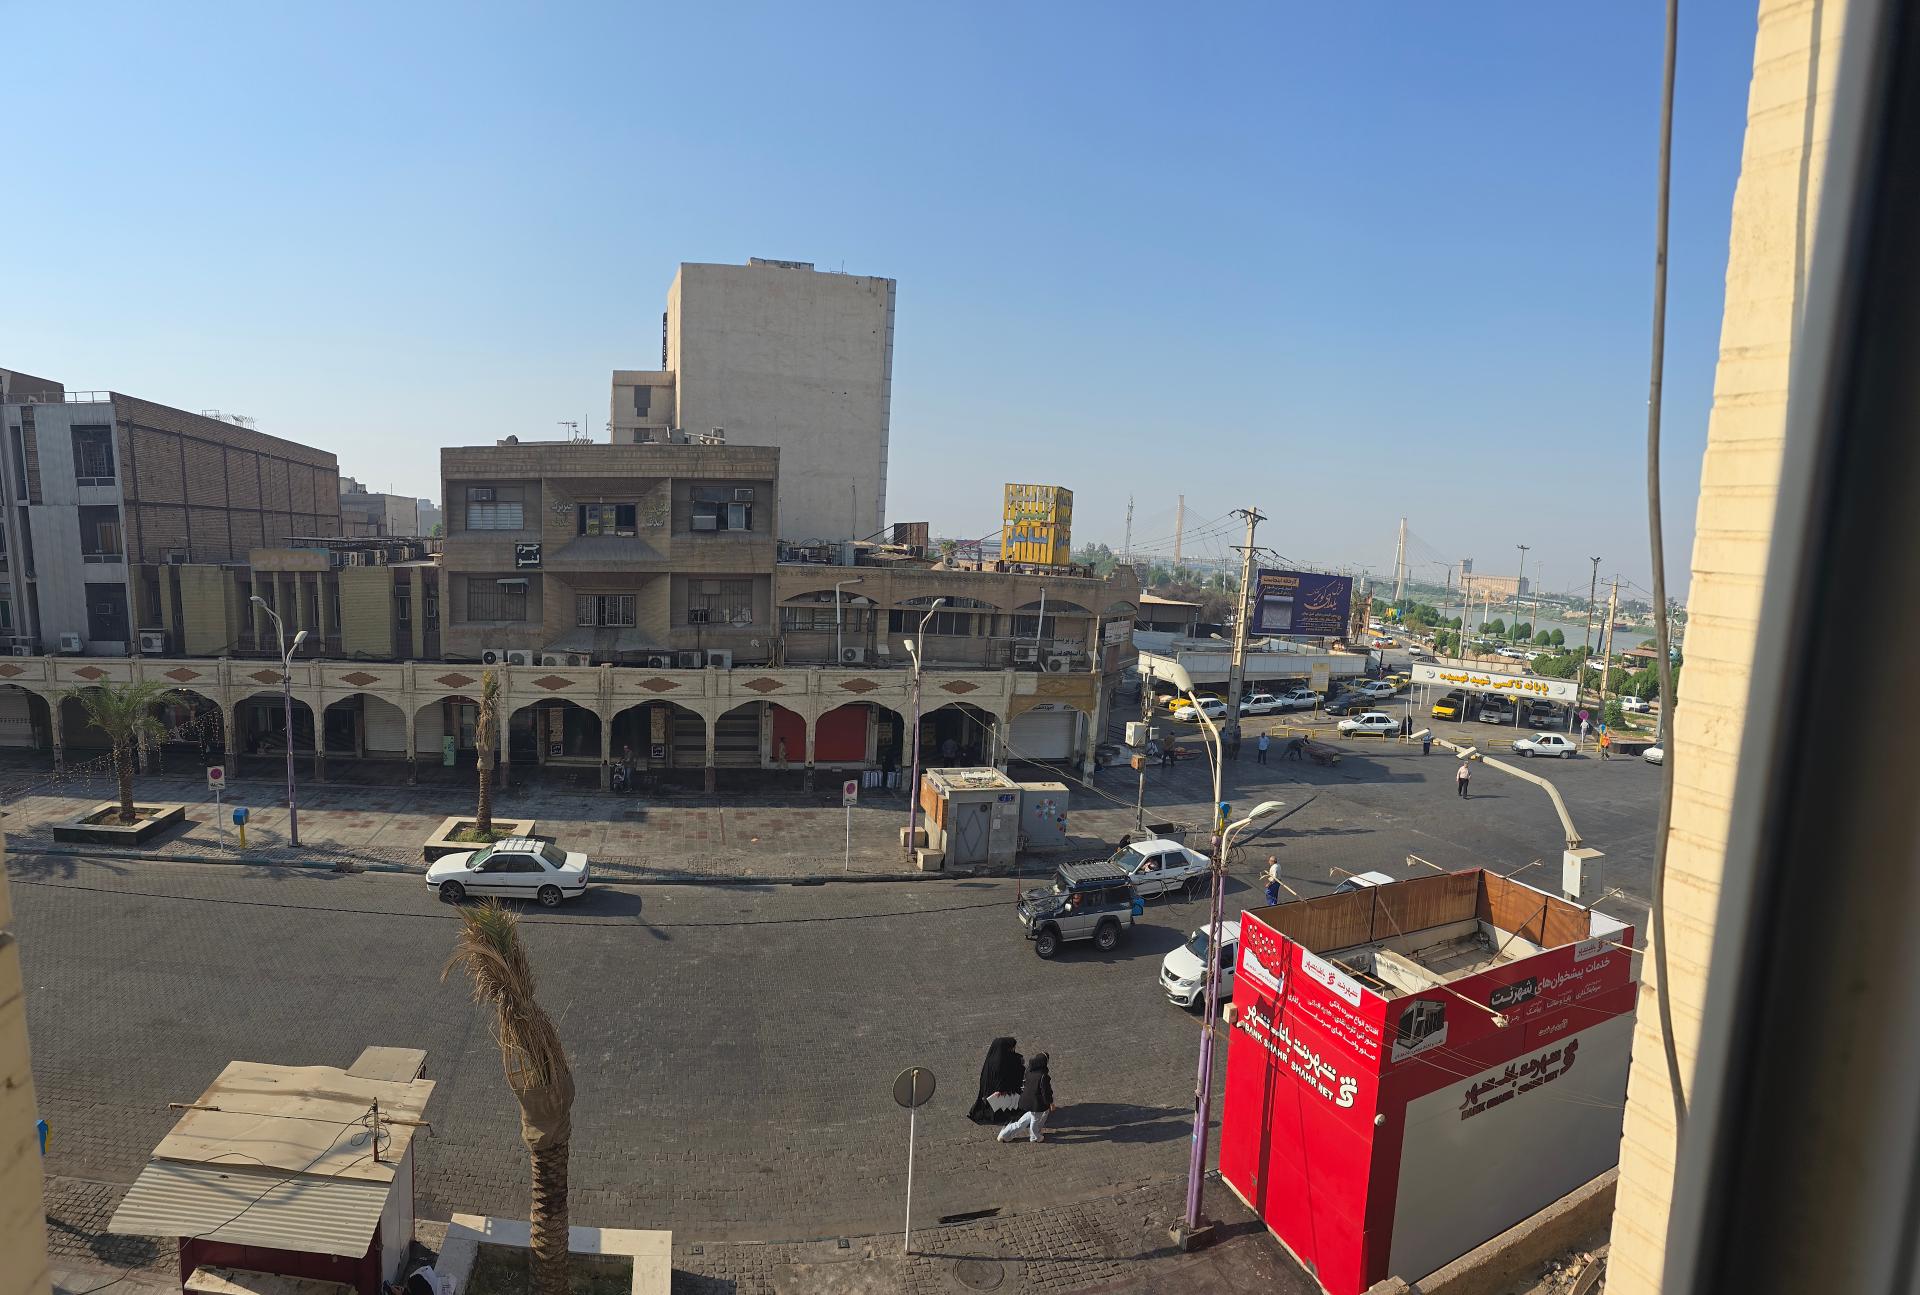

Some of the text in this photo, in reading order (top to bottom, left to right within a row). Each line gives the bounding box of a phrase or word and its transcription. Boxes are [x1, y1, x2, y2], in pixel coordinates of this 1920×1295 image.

[1439, 672, 1549, 696] پایانه تاکسی شهید فهمیده
[1585, 957, 1611, 974] خدمات
[1491, 980, 1535, 1006] شهرنت
[1244, 1005, 1337, 1082] شهرنت بانک شهر
[1245, 1022, 1333, 1101] BANK SHAHR SHAHR NET
